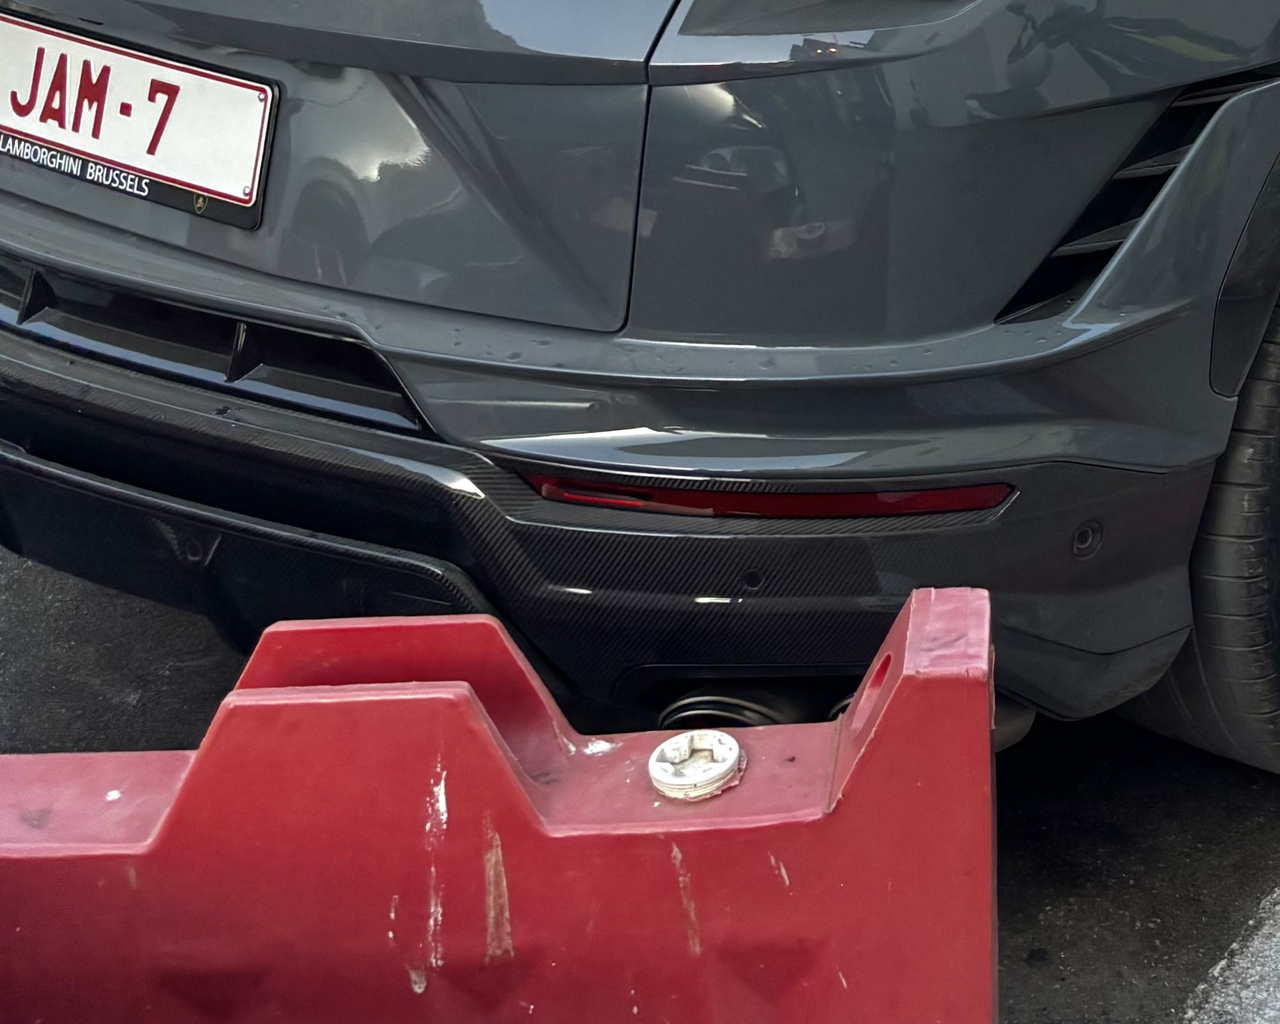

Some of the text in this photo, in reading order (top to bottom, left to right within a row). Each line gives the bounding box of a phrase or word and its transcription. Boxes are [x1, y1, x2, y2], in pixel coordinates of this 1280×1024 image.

[10, 46, 181, 156] JAM-7
[0, 134, 150, 197] LAMBORGHINI BRUSSELS
